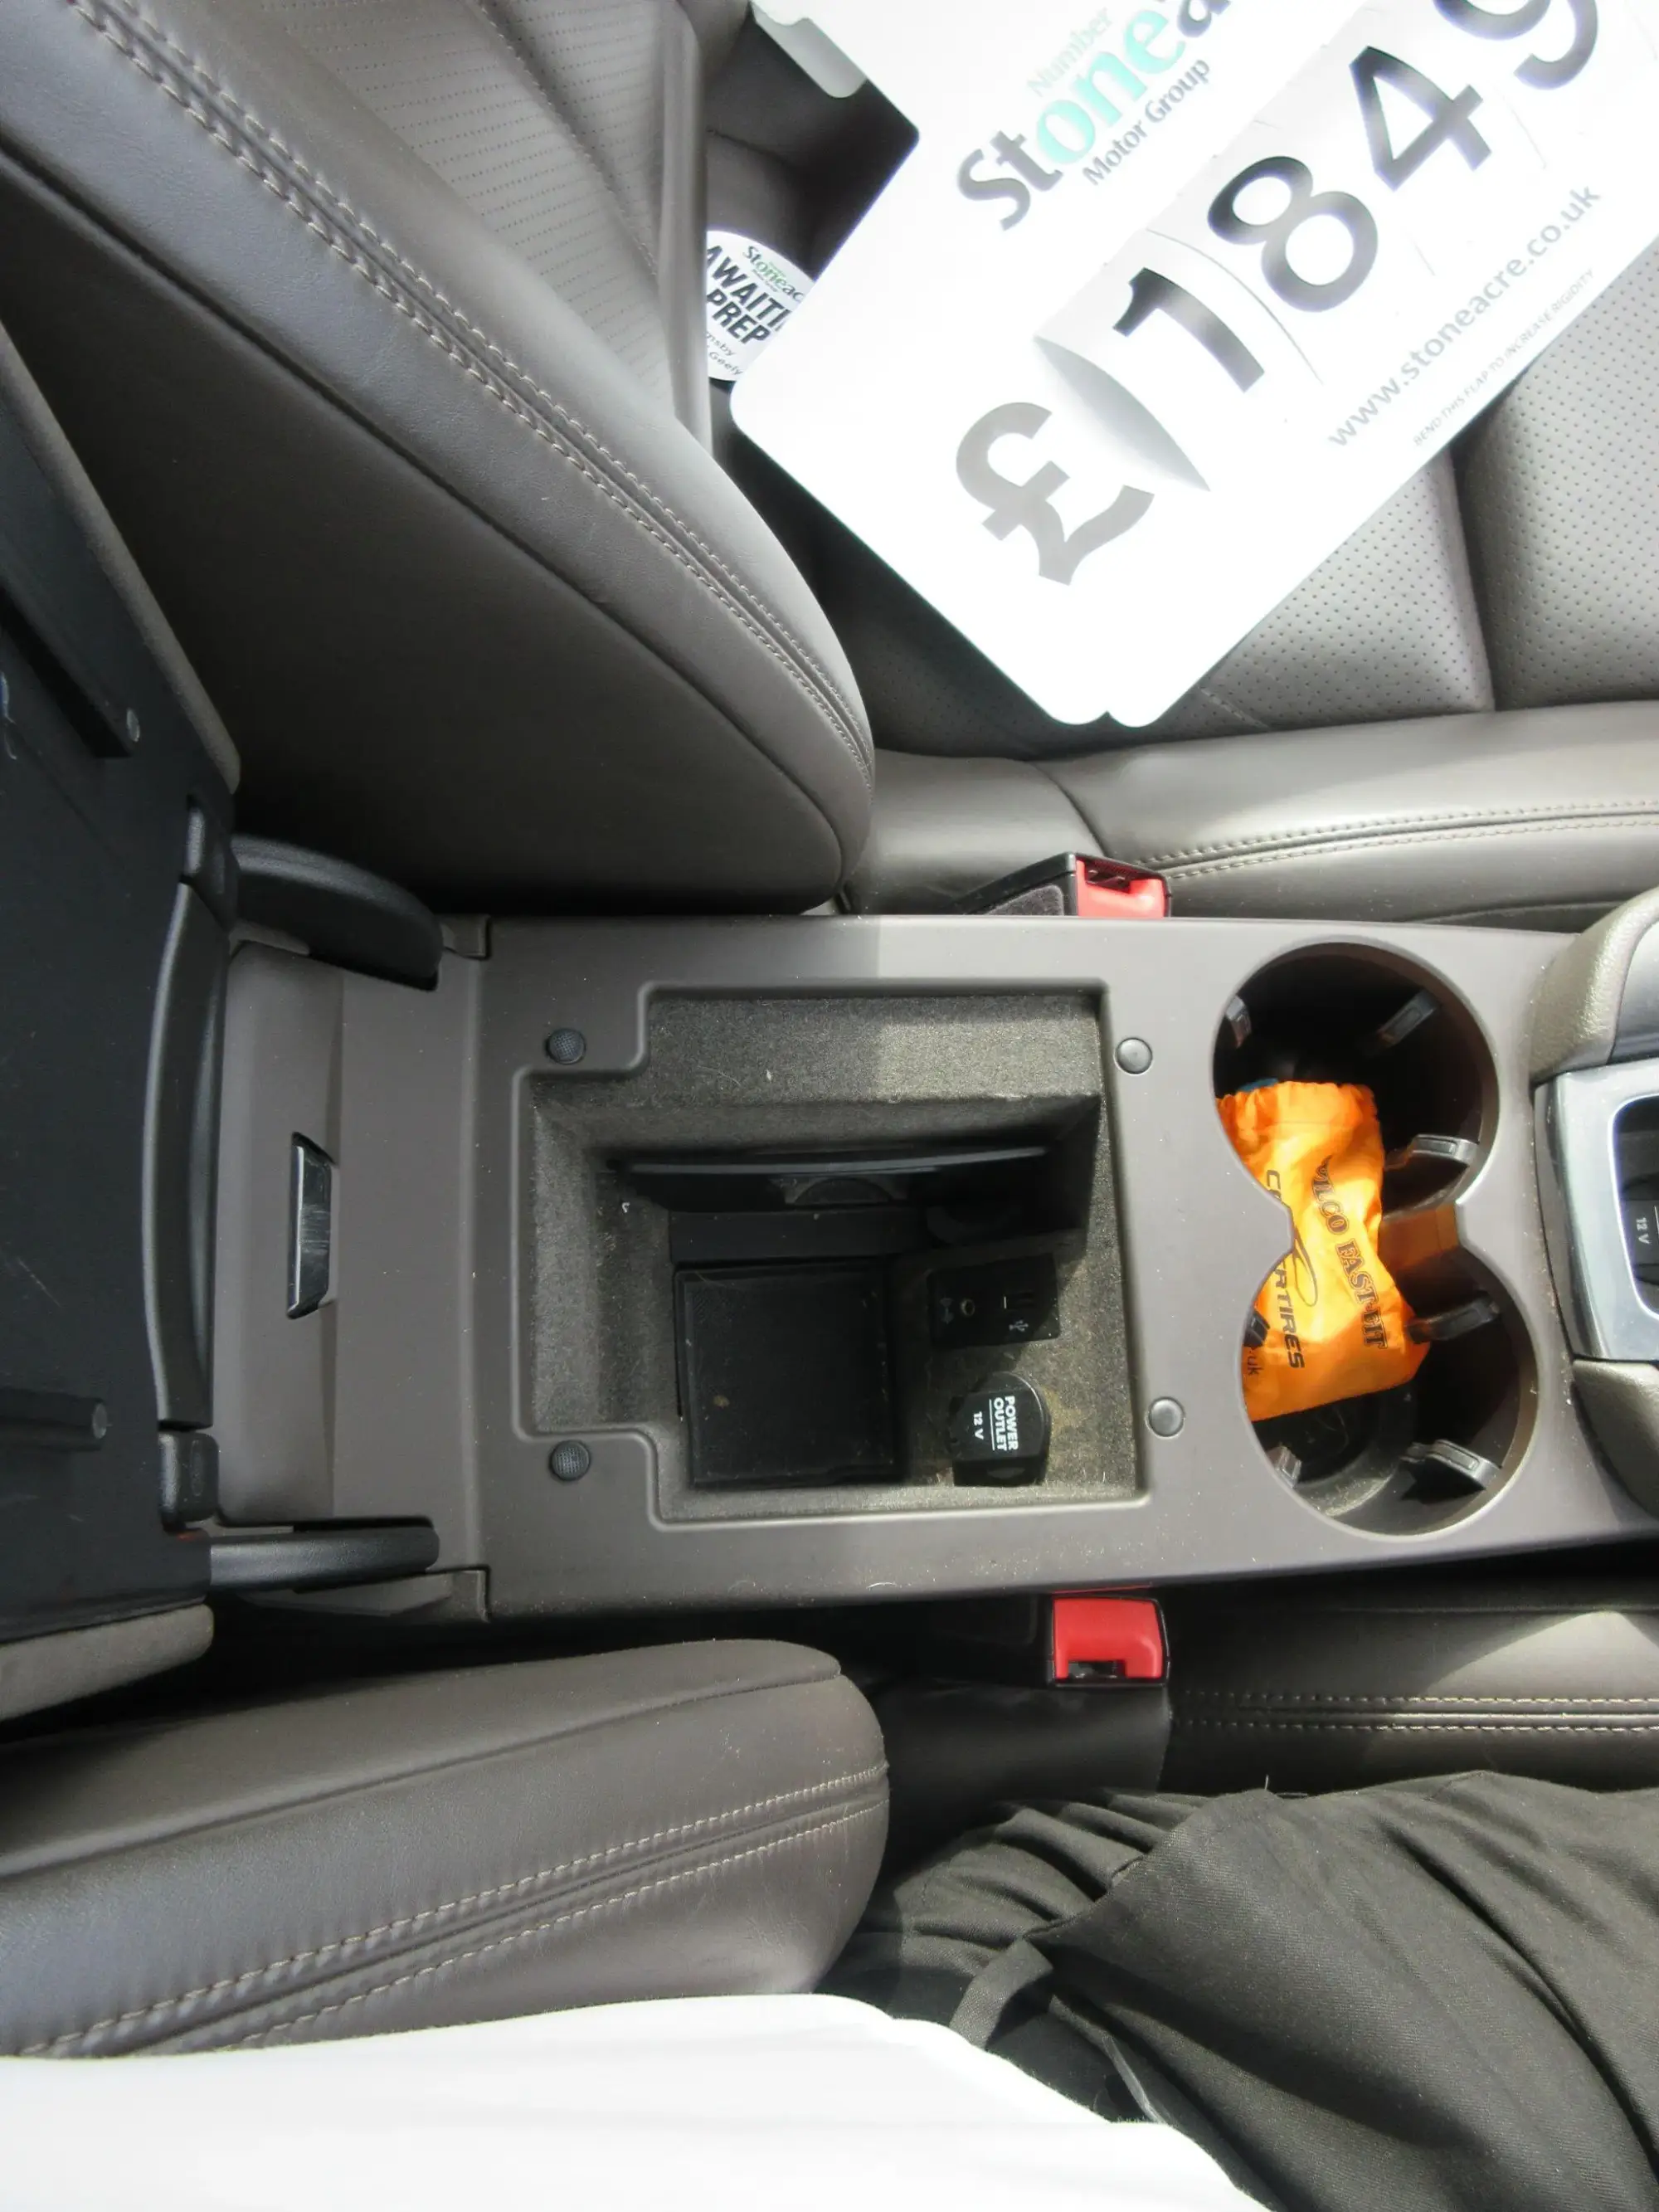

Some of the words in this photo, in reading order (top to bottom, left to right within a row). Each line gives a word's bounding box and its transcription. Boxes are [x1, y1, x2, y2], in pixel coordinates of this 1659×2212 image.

[1082, 120, 1149, 186] Motor
[1145, 59, 1210, 124] Group
[707, 246, 792, 332] AWAITI
[1328, 186, 1601, 446] www.stoneacre.co.uk
[707, 289, 771, 344] PREP
[1413, 417, 1442, 446] BEND
[1442, 395, 1465, 419] THIS
[1463, 370, 1489, 397] FLAP
[1488, 357, 1504, 372] TO
[1504, 309, 1553, 358] INCREASE
[1551, 269, 1594, 314] RIGIDITY
[1636, 1217, 1647, 1231] 12
[973, 1411, 983, 1425] 12
[975, 1428, 984, 1440] V
[994, 1397, 1007, 1450] OUTLET
[1005, 1396, 1019, 1450] POWER
